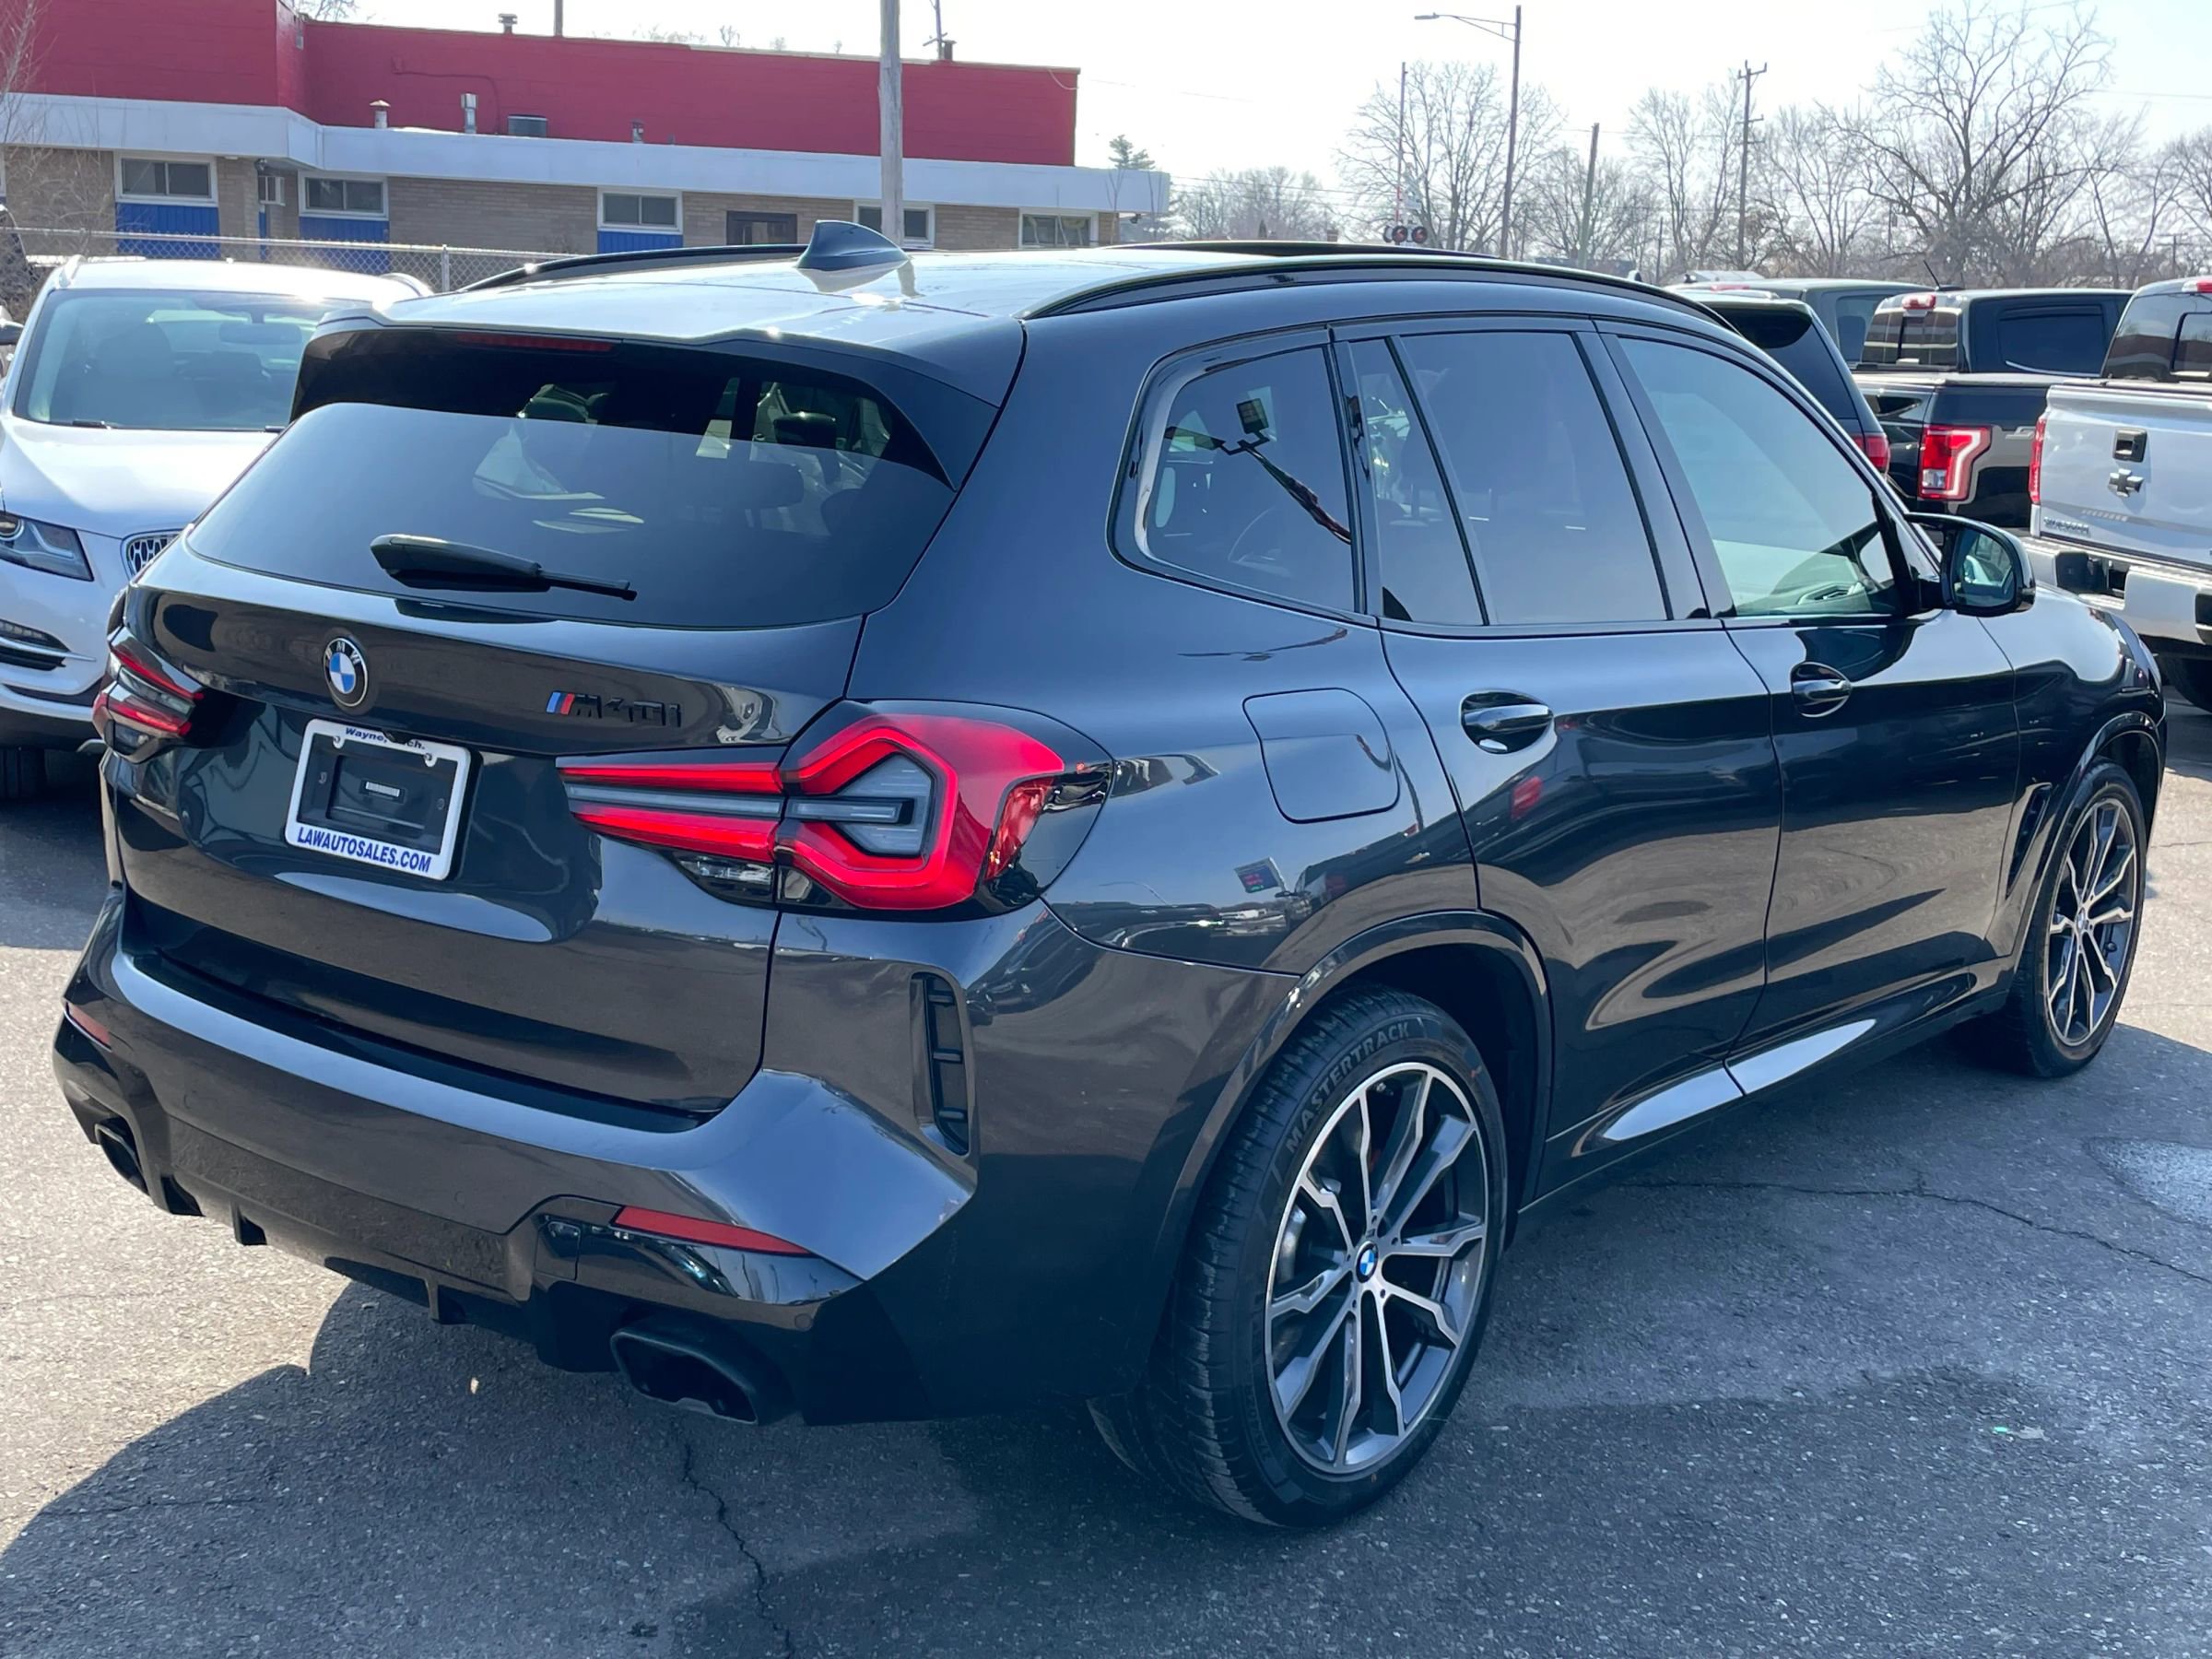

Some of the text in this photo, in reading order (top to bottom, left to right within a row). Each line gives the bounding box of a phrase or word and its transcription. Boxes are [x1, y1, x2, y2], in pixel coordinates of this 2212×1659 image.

[346, 726, 388, 744] Wayne,
[297, 826, 432, 873] LAWAUTOSALES.COM
[1285, 1021, 1409, 1153] MASTERTRACK
